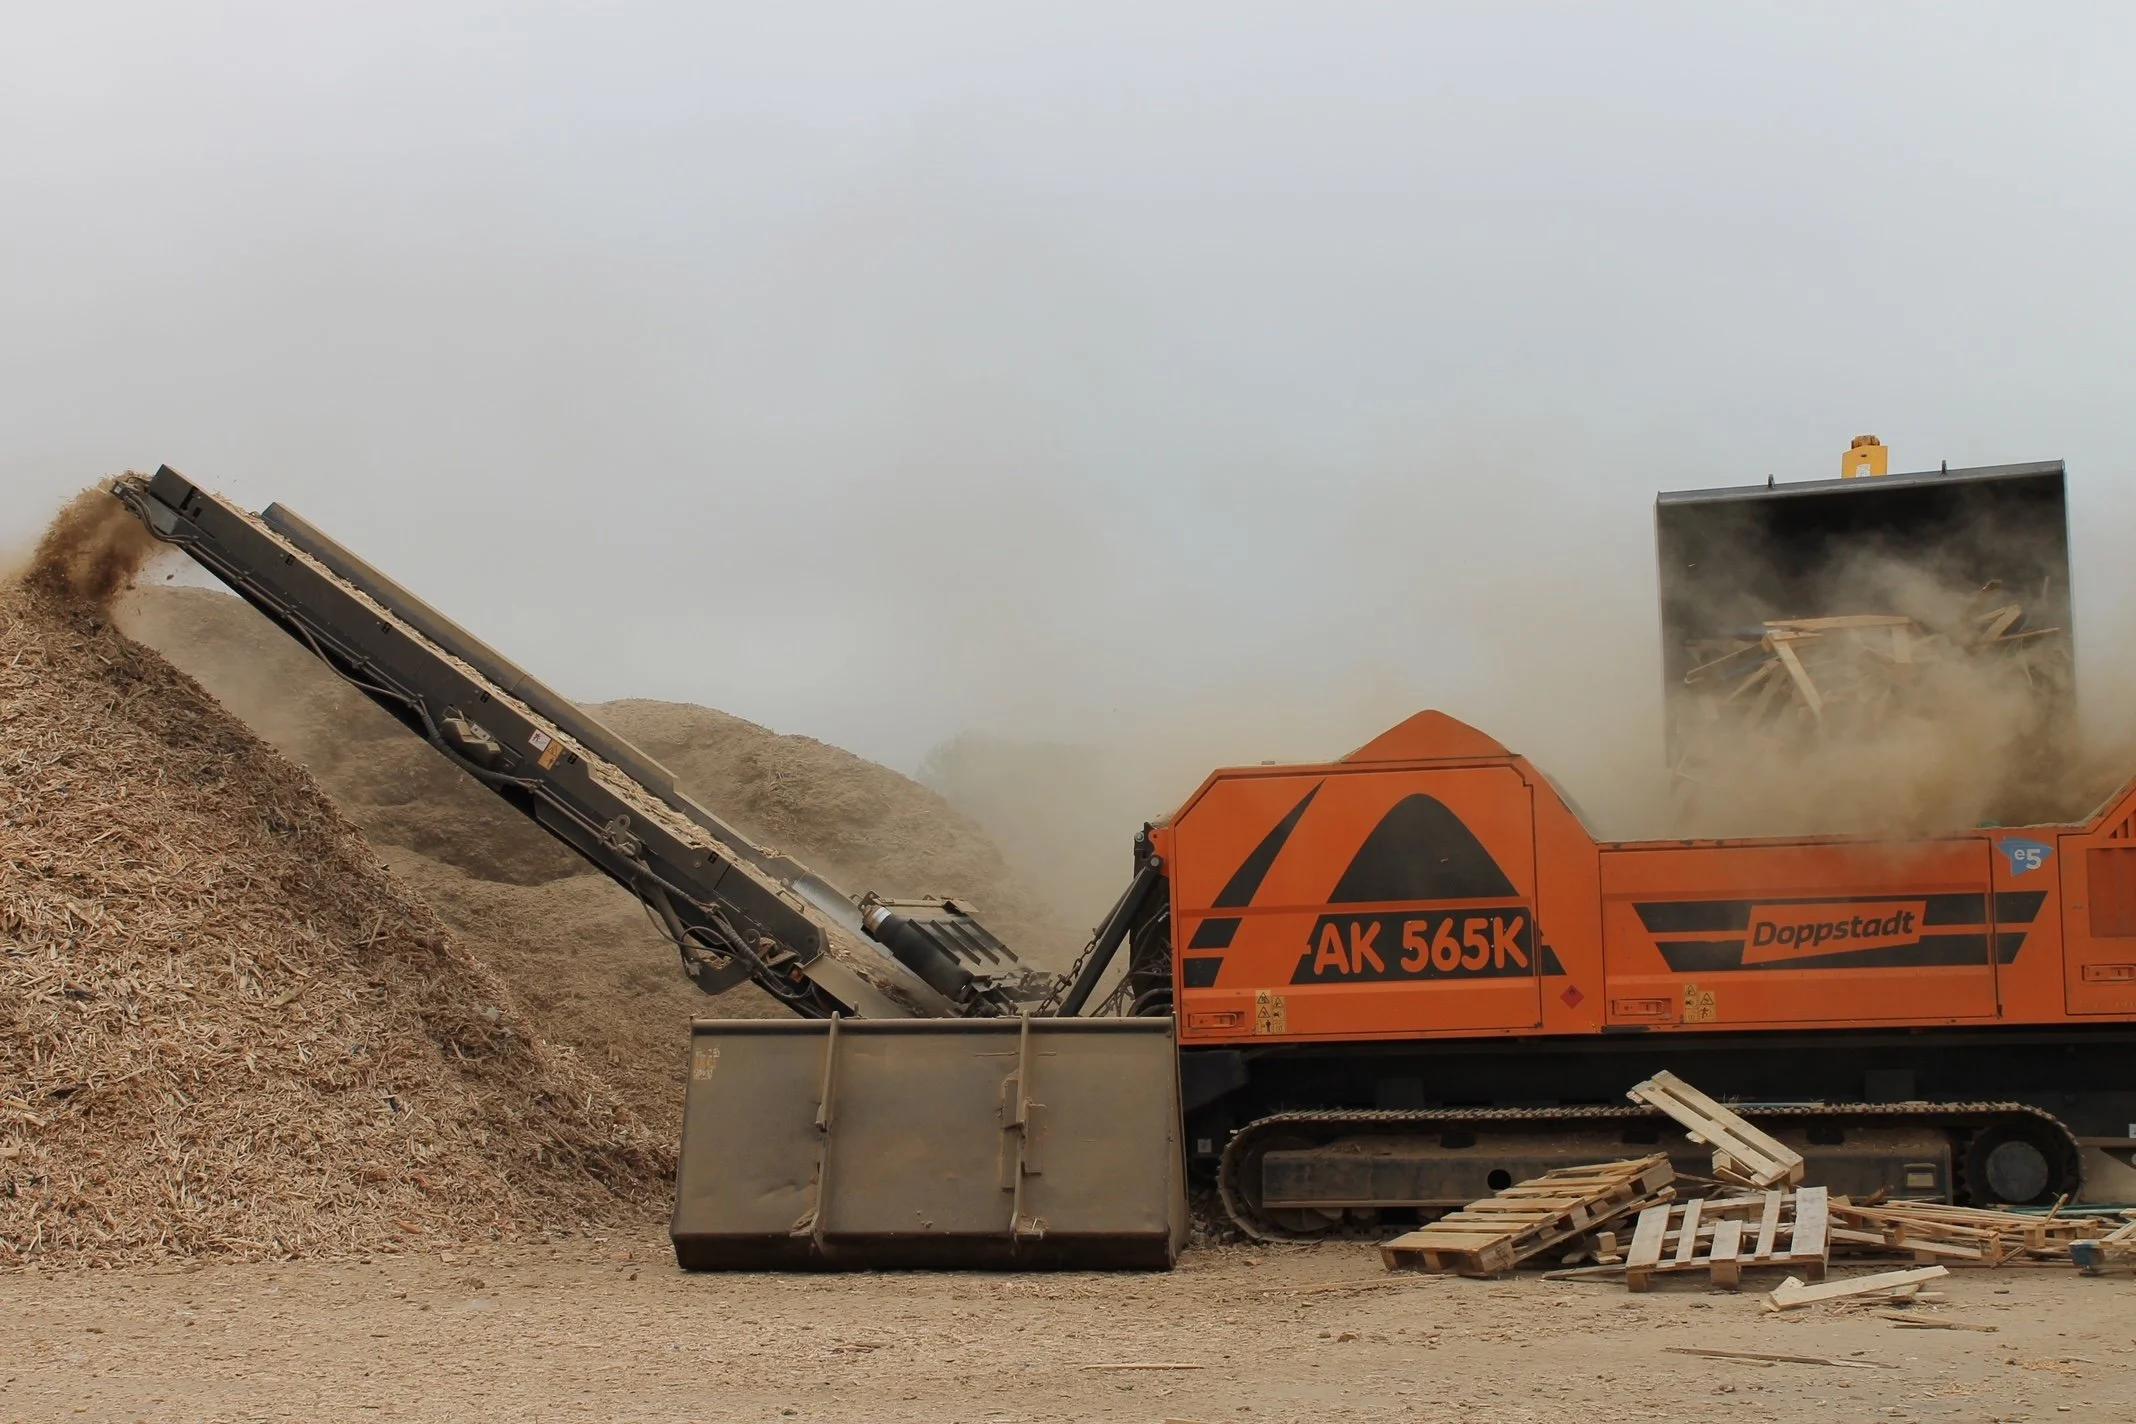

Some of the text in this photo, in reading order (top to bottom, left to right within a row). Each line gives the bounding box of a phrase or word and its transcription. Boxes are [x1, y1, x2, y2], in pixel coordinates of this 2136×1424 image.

[2014, 848, 2042, 870] e5
[1314, 916, 1528, 975] AK 565K
[1753, 910, 1915, 949] Doppstadt
